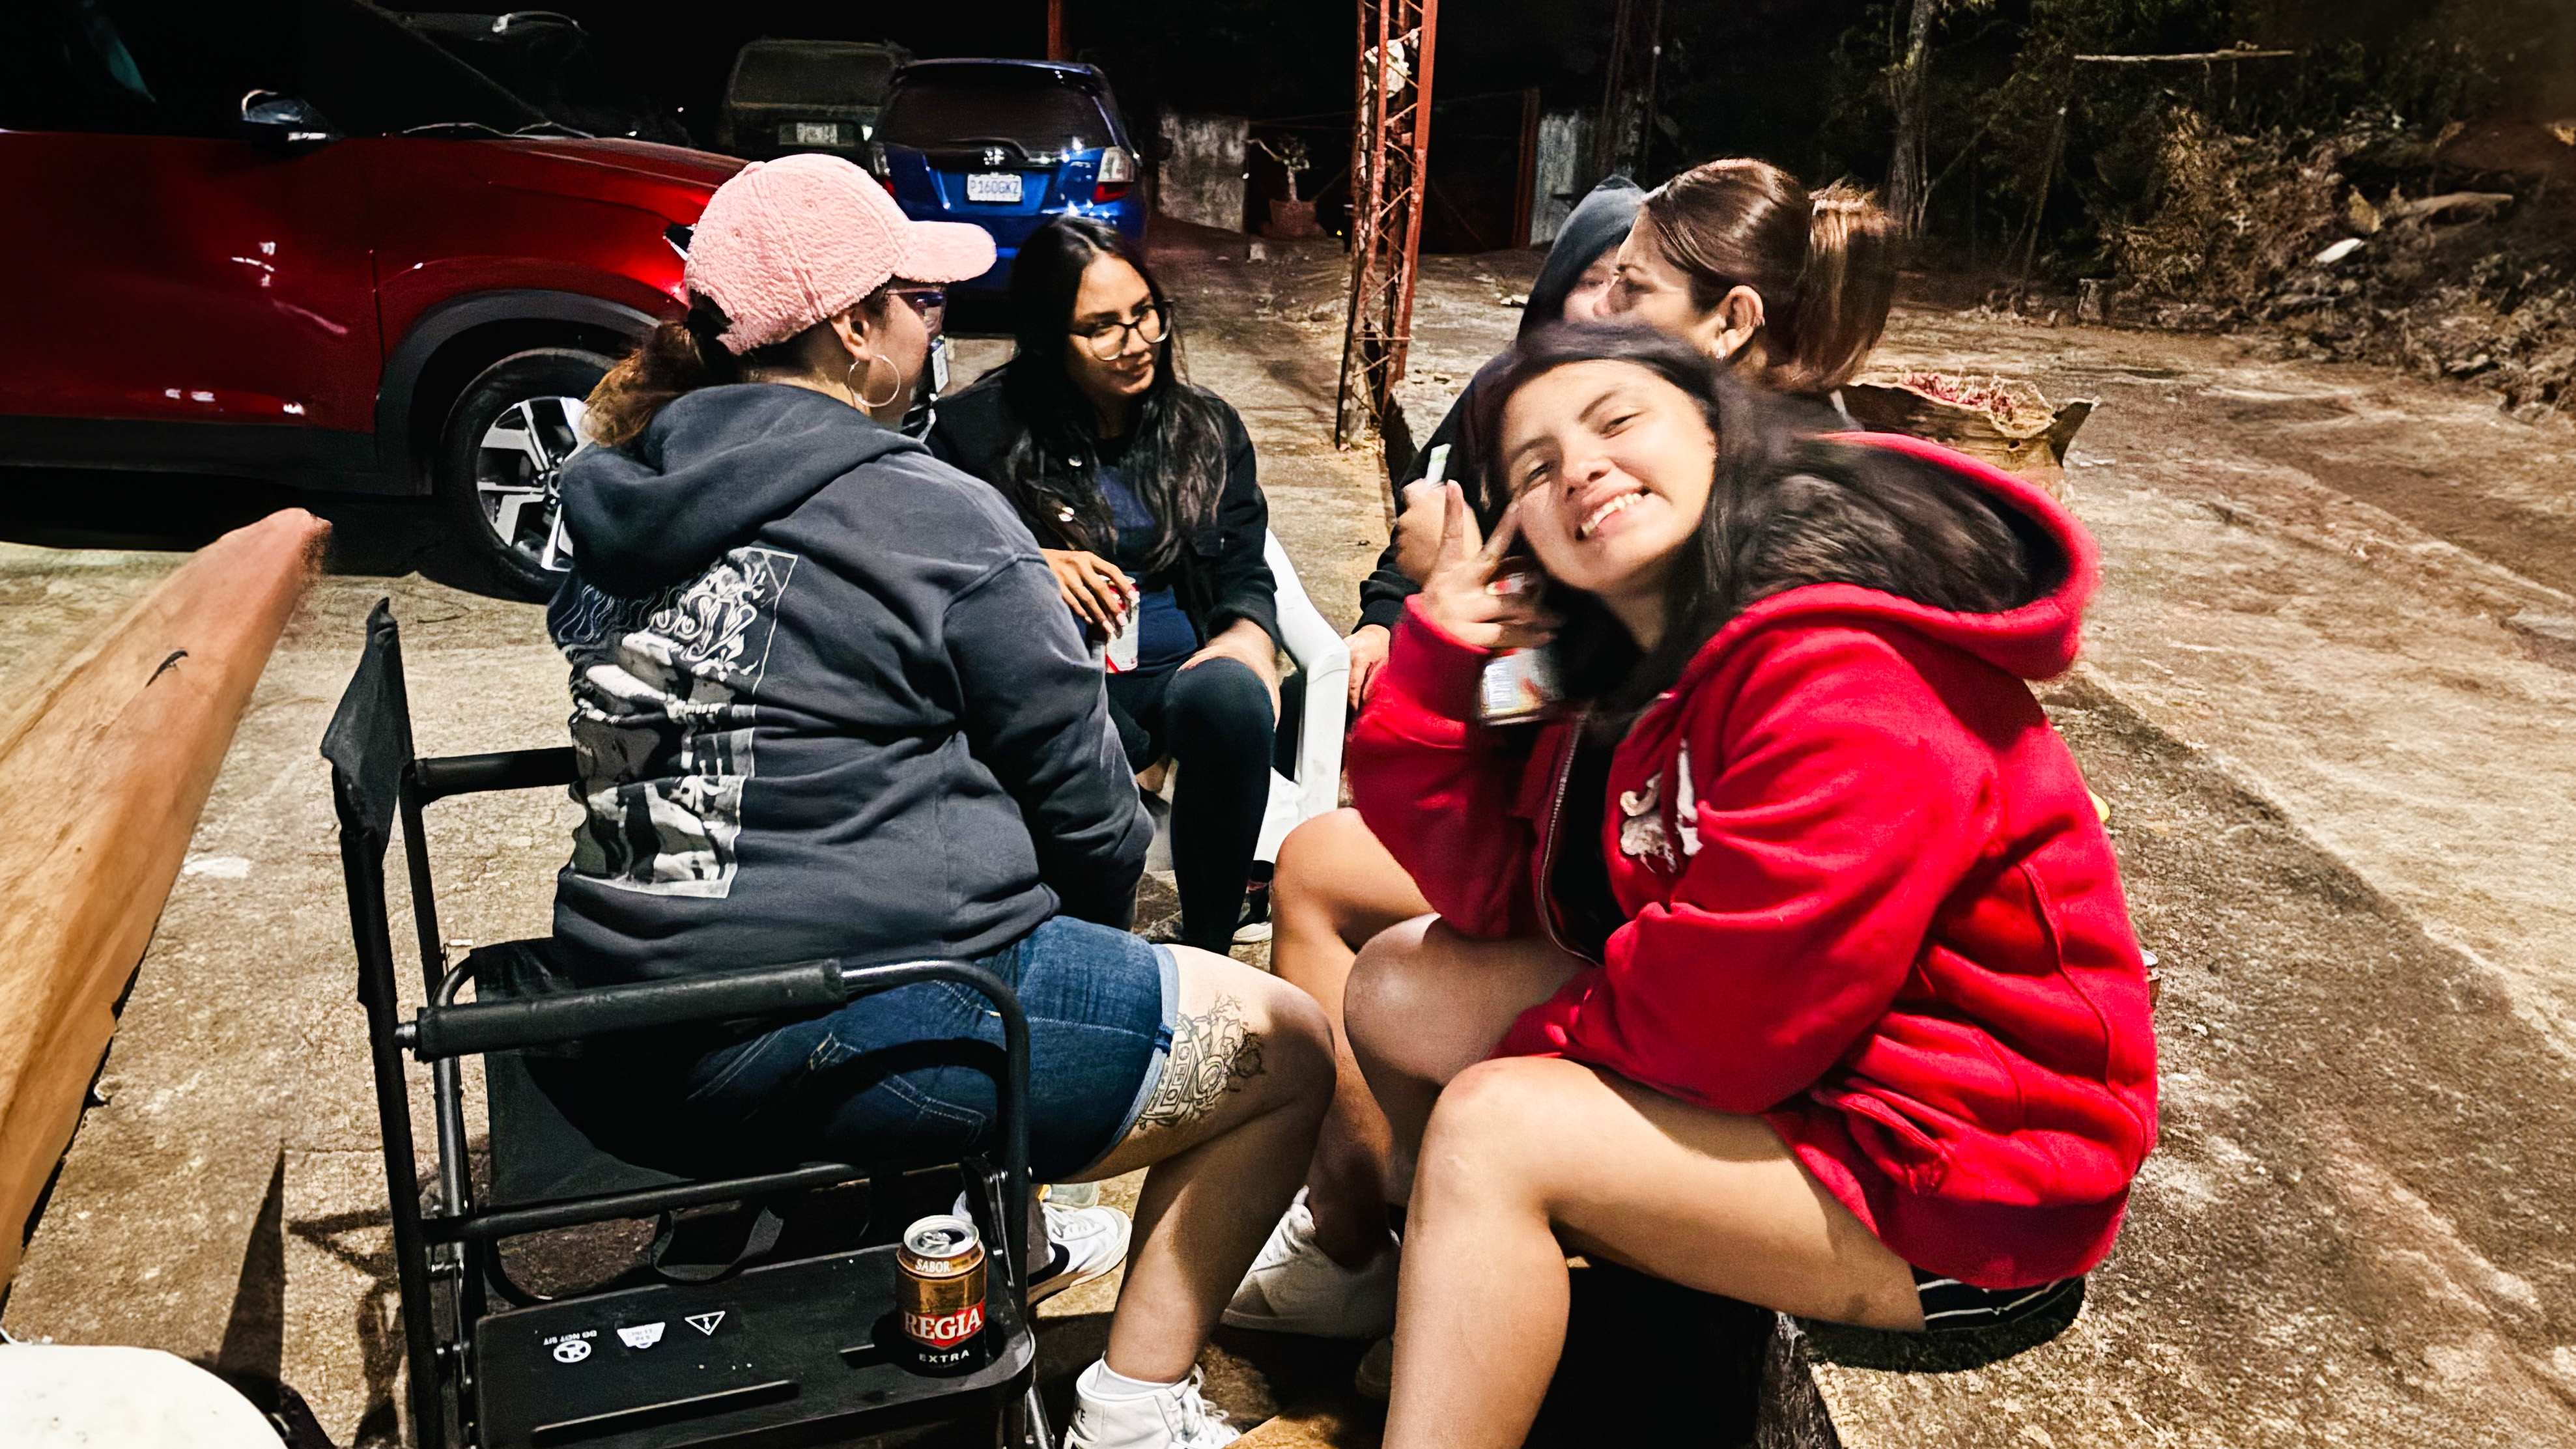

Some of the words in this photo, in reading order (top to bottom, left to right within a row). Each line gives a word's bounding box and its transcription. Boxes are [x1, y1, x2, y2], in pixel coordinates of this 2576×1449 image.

[915, 1258, 951, 1273] SABOR
[904, 1308, 982, 1340] REGIA
[559, 1332, 580, 1342] NOT
[919, 1349, 970, 1363] EXTRA
